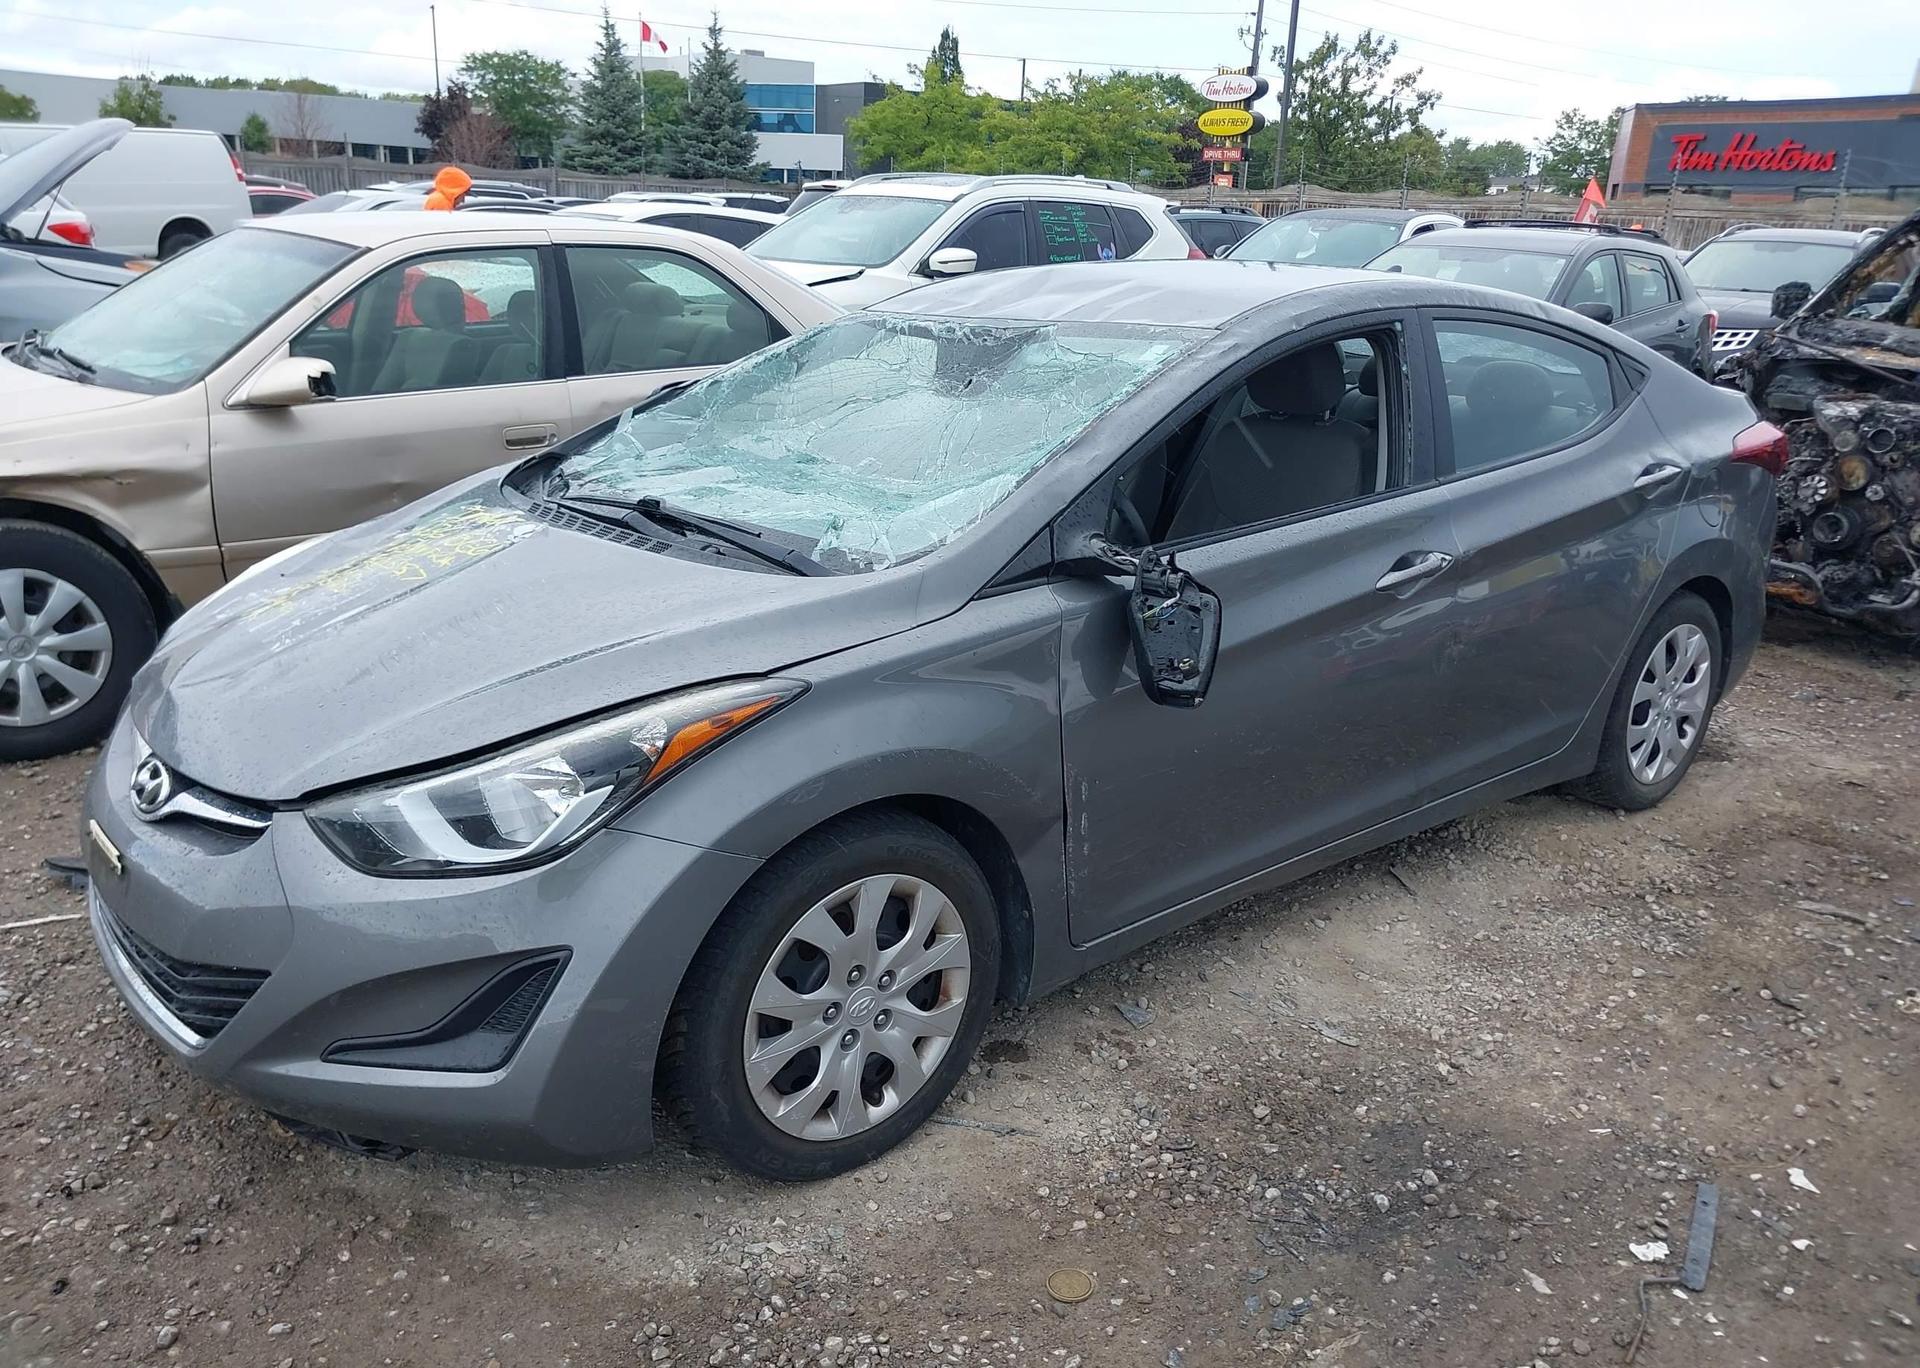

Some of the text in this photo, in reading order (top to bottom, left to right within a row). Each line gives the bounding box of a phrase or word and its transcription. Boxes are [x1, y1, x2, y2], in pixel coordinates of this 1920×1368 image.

[1206, 80, 1252, 96] Tim Hortons
[1202, 117, 1250, 127] ALWAYS FRESH
[1204, 150, 1241, 159] DRIVE THRU
[1668, 132, 1836, 171] Tim Hortons
